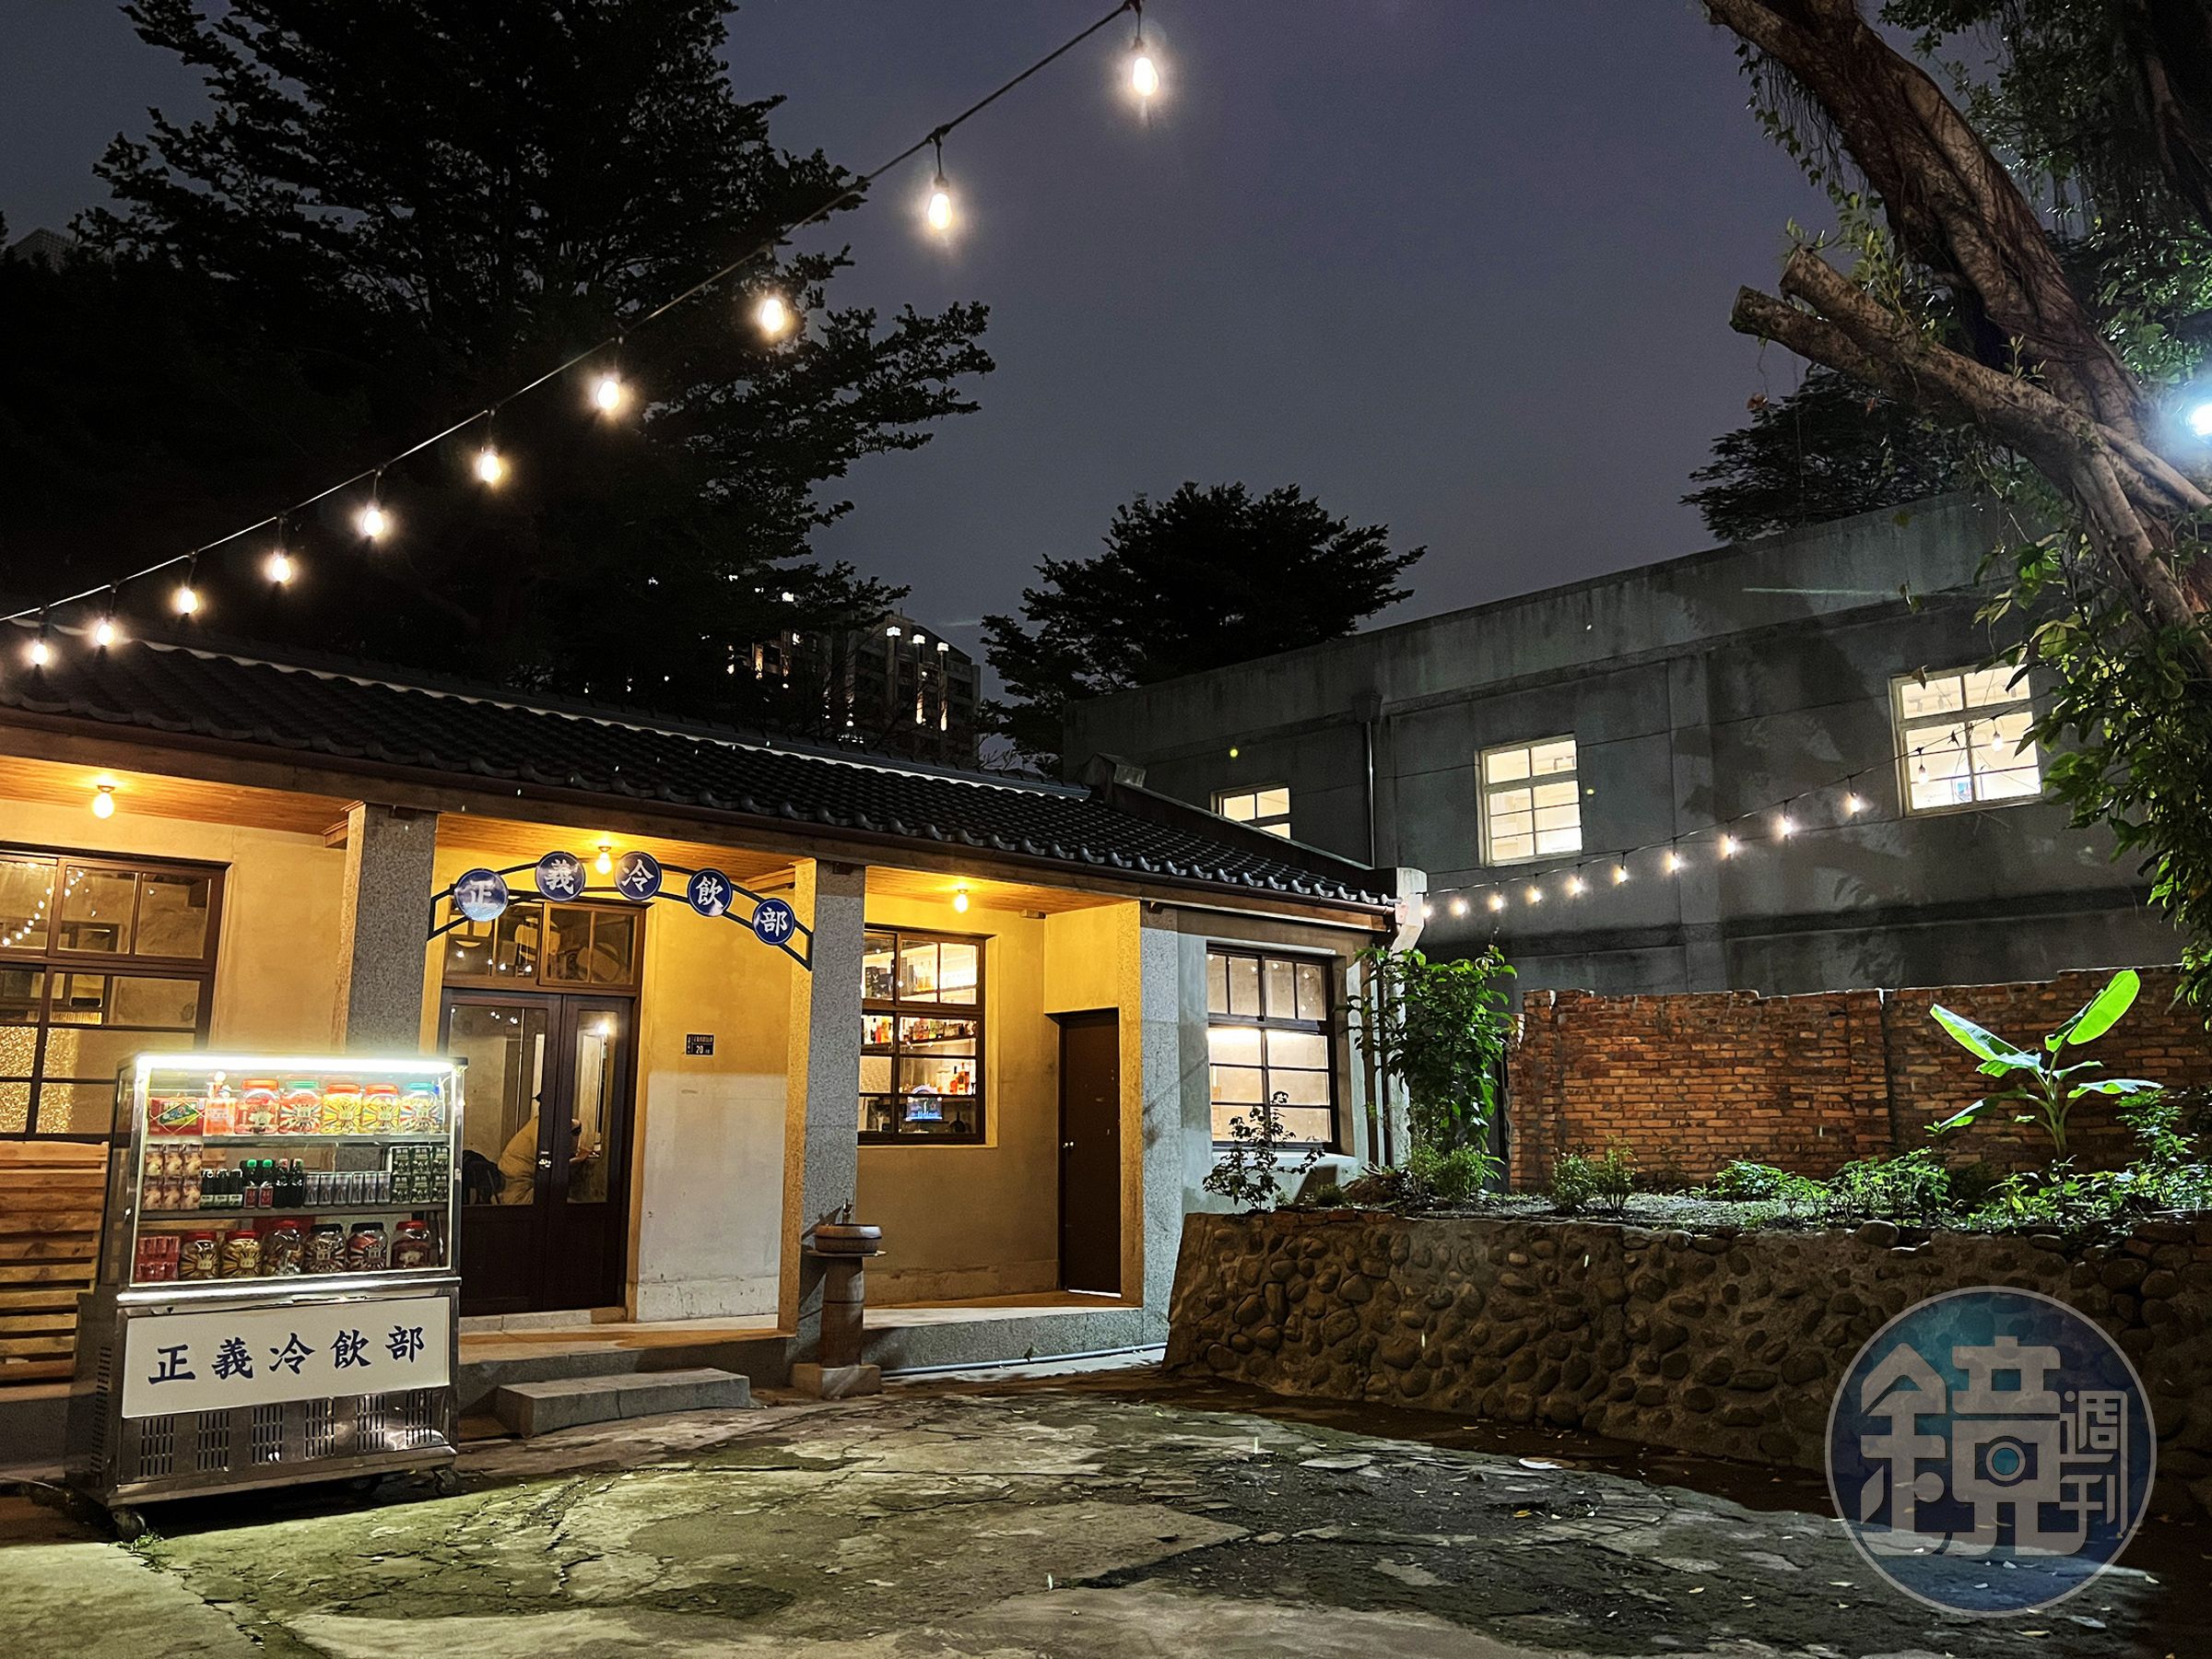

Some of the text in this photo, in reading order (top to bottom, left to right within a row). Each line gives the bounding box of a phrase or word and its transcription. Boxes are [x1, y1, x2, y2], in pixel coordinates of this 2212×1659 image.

[469, 858, 788, 937] 正義冷飲部
[147, 1325, 425, 1384] 正義冷飲部
